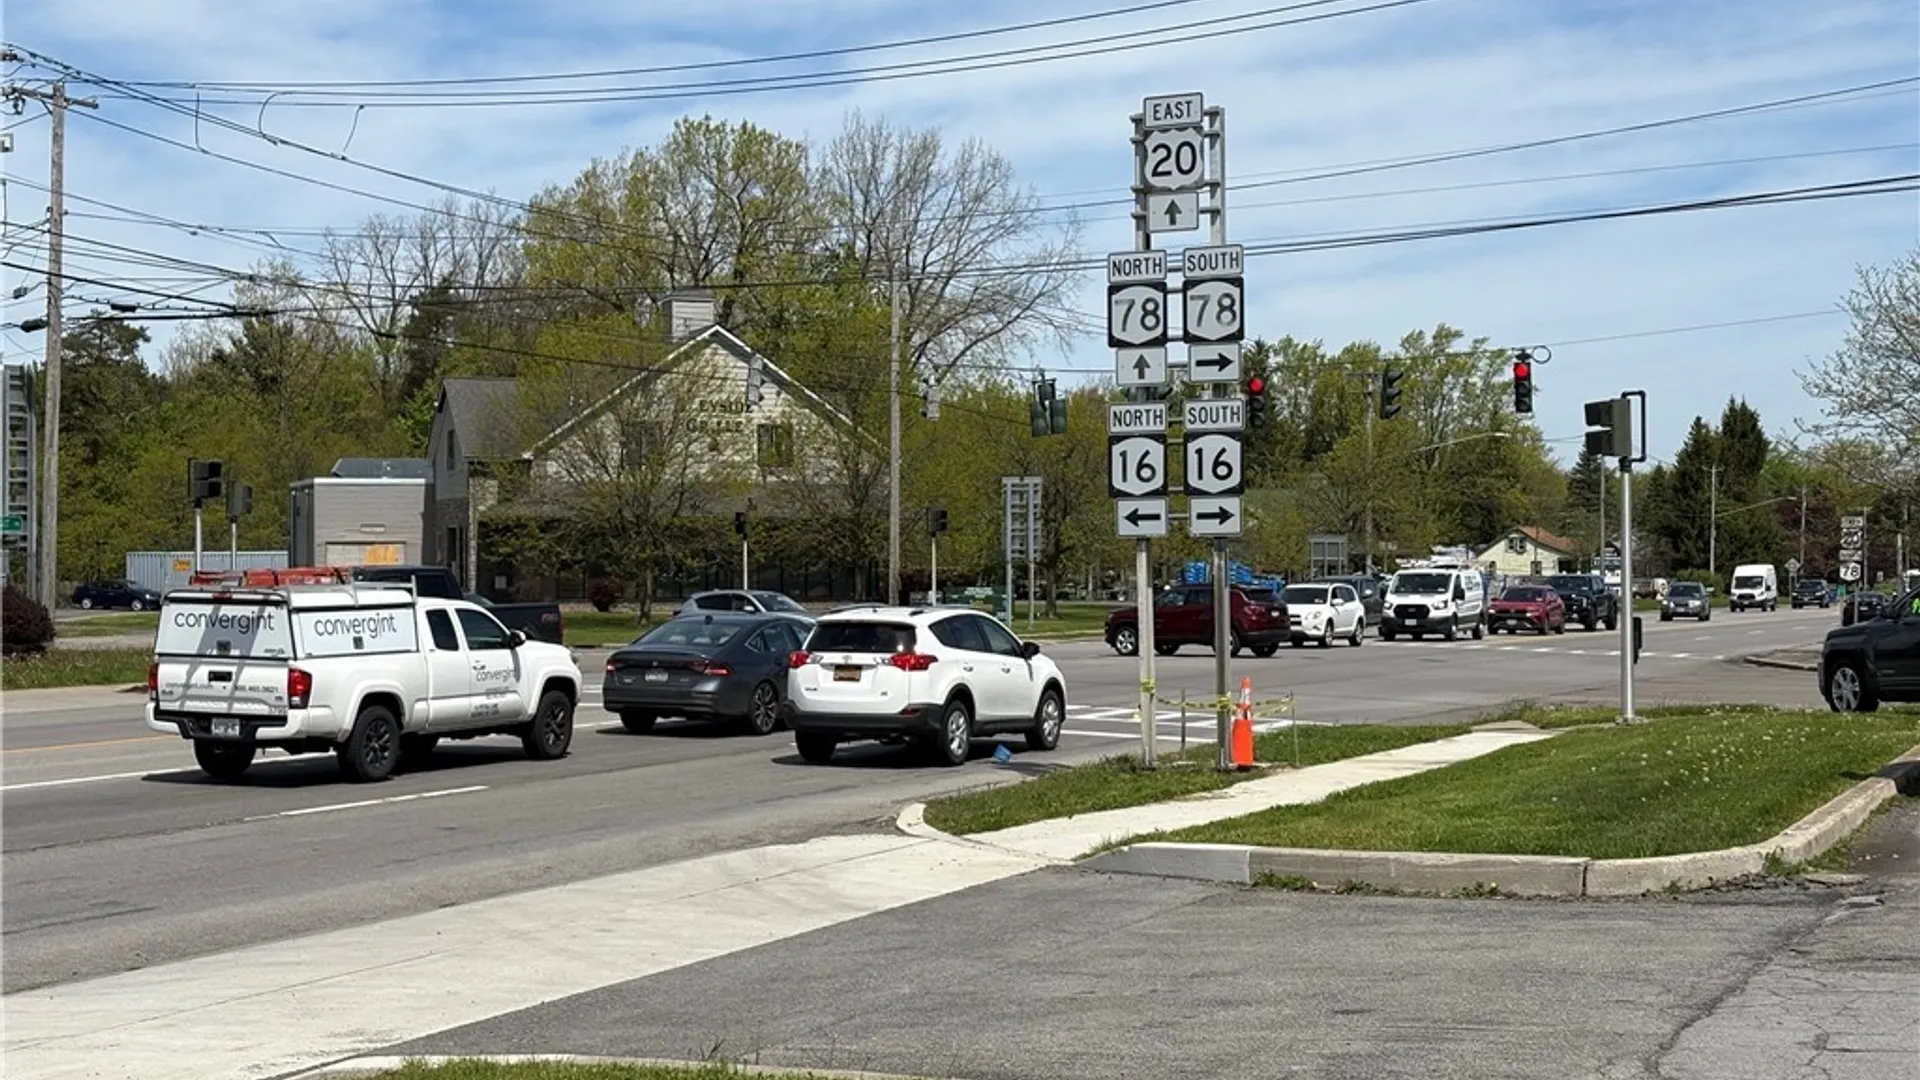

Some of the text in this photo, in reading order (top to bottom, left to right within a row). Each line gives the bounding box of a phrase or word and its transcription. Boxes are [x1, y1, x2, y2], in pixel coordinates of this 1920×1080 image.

[1153, 101, 1193, 121] EAST
[1151, 141, 1198, 177] 20
[1112, 257, 1162, 276] NORTH
[1186, 252, 1240, 272] SOUTH
[1114, 297, 1161, 332] 78
[1189, 292, 1237, 327] 78
[1112, 408, 1164, 427] NORTH
[1188, 404, 1241, 425] SOUTH
[1119, 450, 1156, 483] 16
[1195, 447, 1233, 481] 16
[1842, 565, 1860, 578] 78
[174, 610, 275, 634] convergint
[314, 612, 398, 638] convergint
